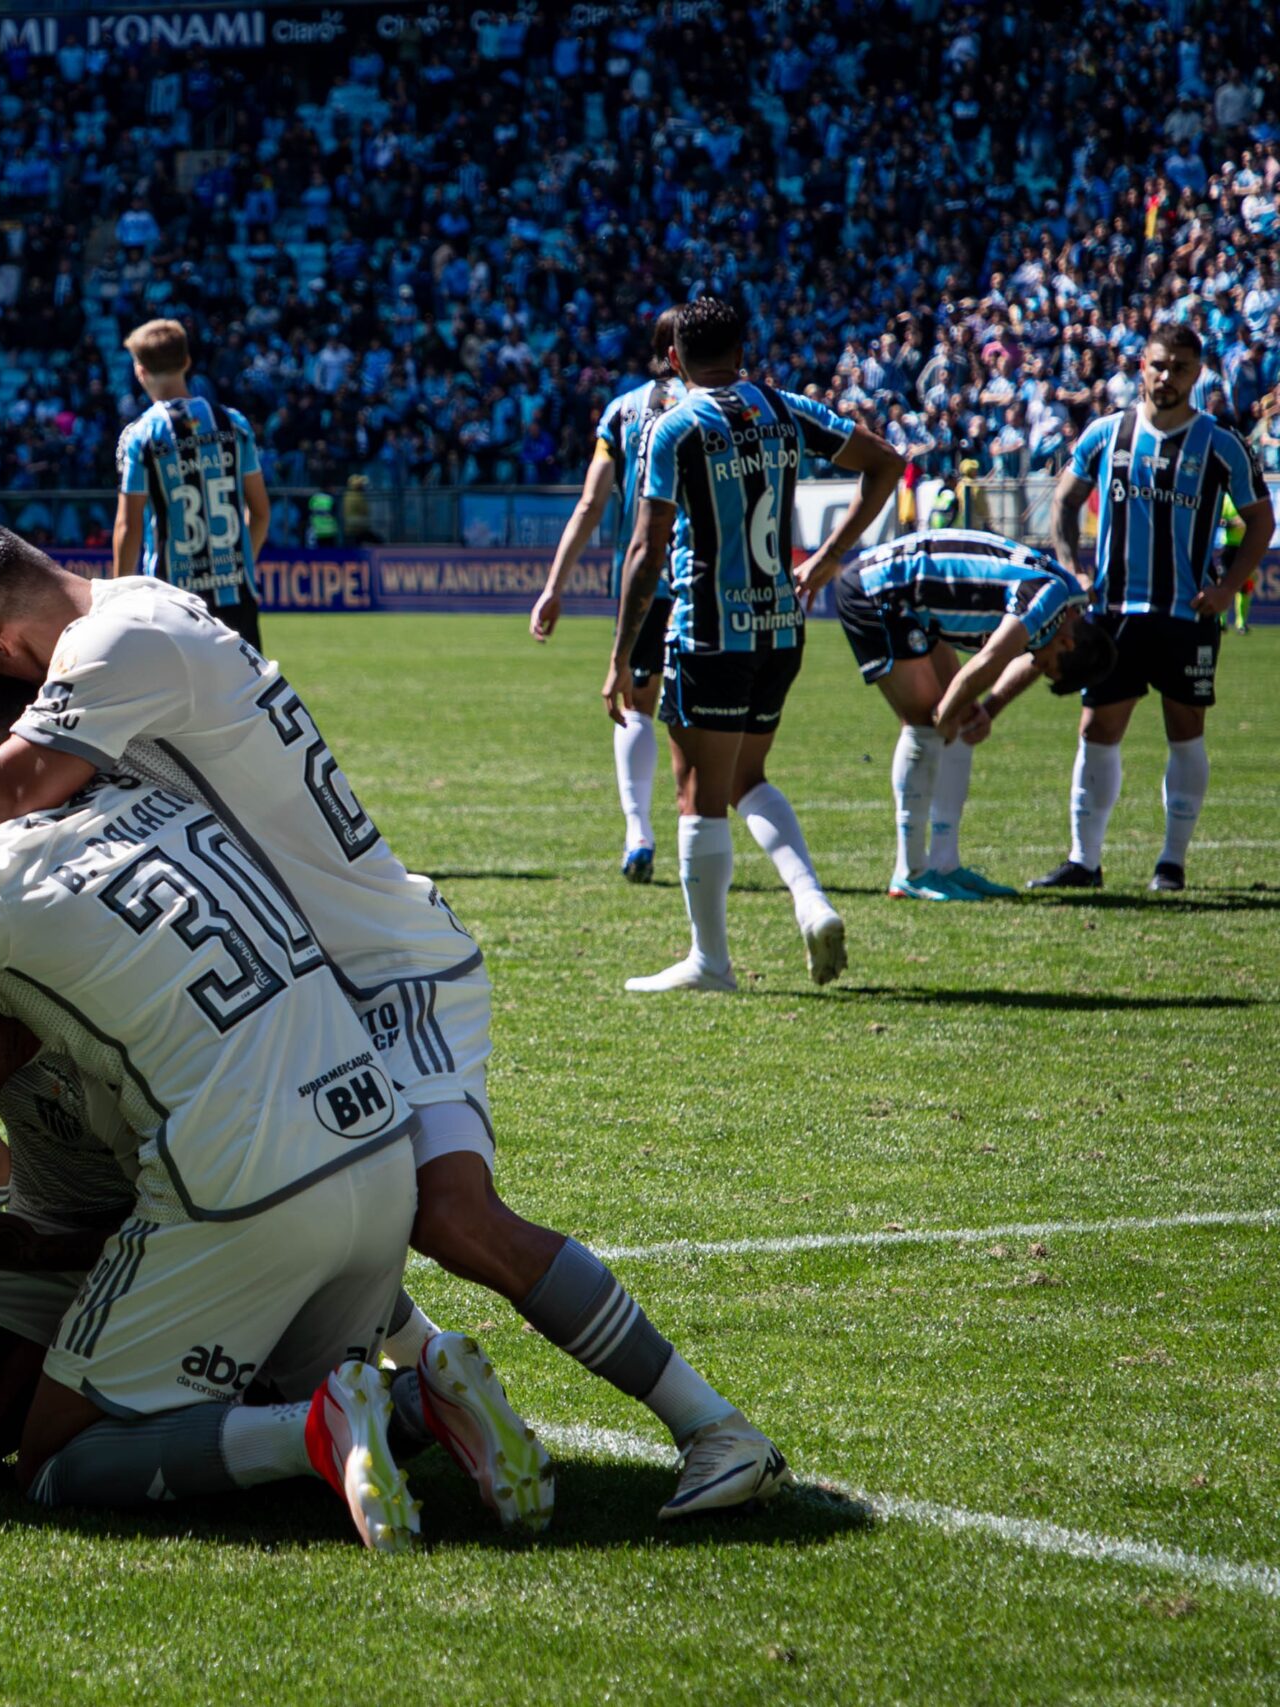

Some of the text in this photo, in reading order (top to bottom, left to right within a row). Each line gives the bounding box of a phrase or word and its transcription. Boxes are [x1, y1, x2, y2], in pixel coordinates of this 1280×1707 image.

[87, 10, 266, 48] KONAMI
[731, 423, 797, 446] banrisu
[165, 450, 235, 478] RONALD
[715, 449, 798, 483] REINALDO
[170, 474, 241, 556] 35
[1128, 482, 1202, 511] banrisul
[751, 484, 783, 577] 6
[731, 609, 804, 632] Unimed
[96, 814, 327, 1035] 30
[297, 1051, 375, 1098] SUPERMERCADOS
[325, 1070, 388, 1132] BH
[176, 1374, 191, 1388] da
[181, 1343, 256, 1391] abc
